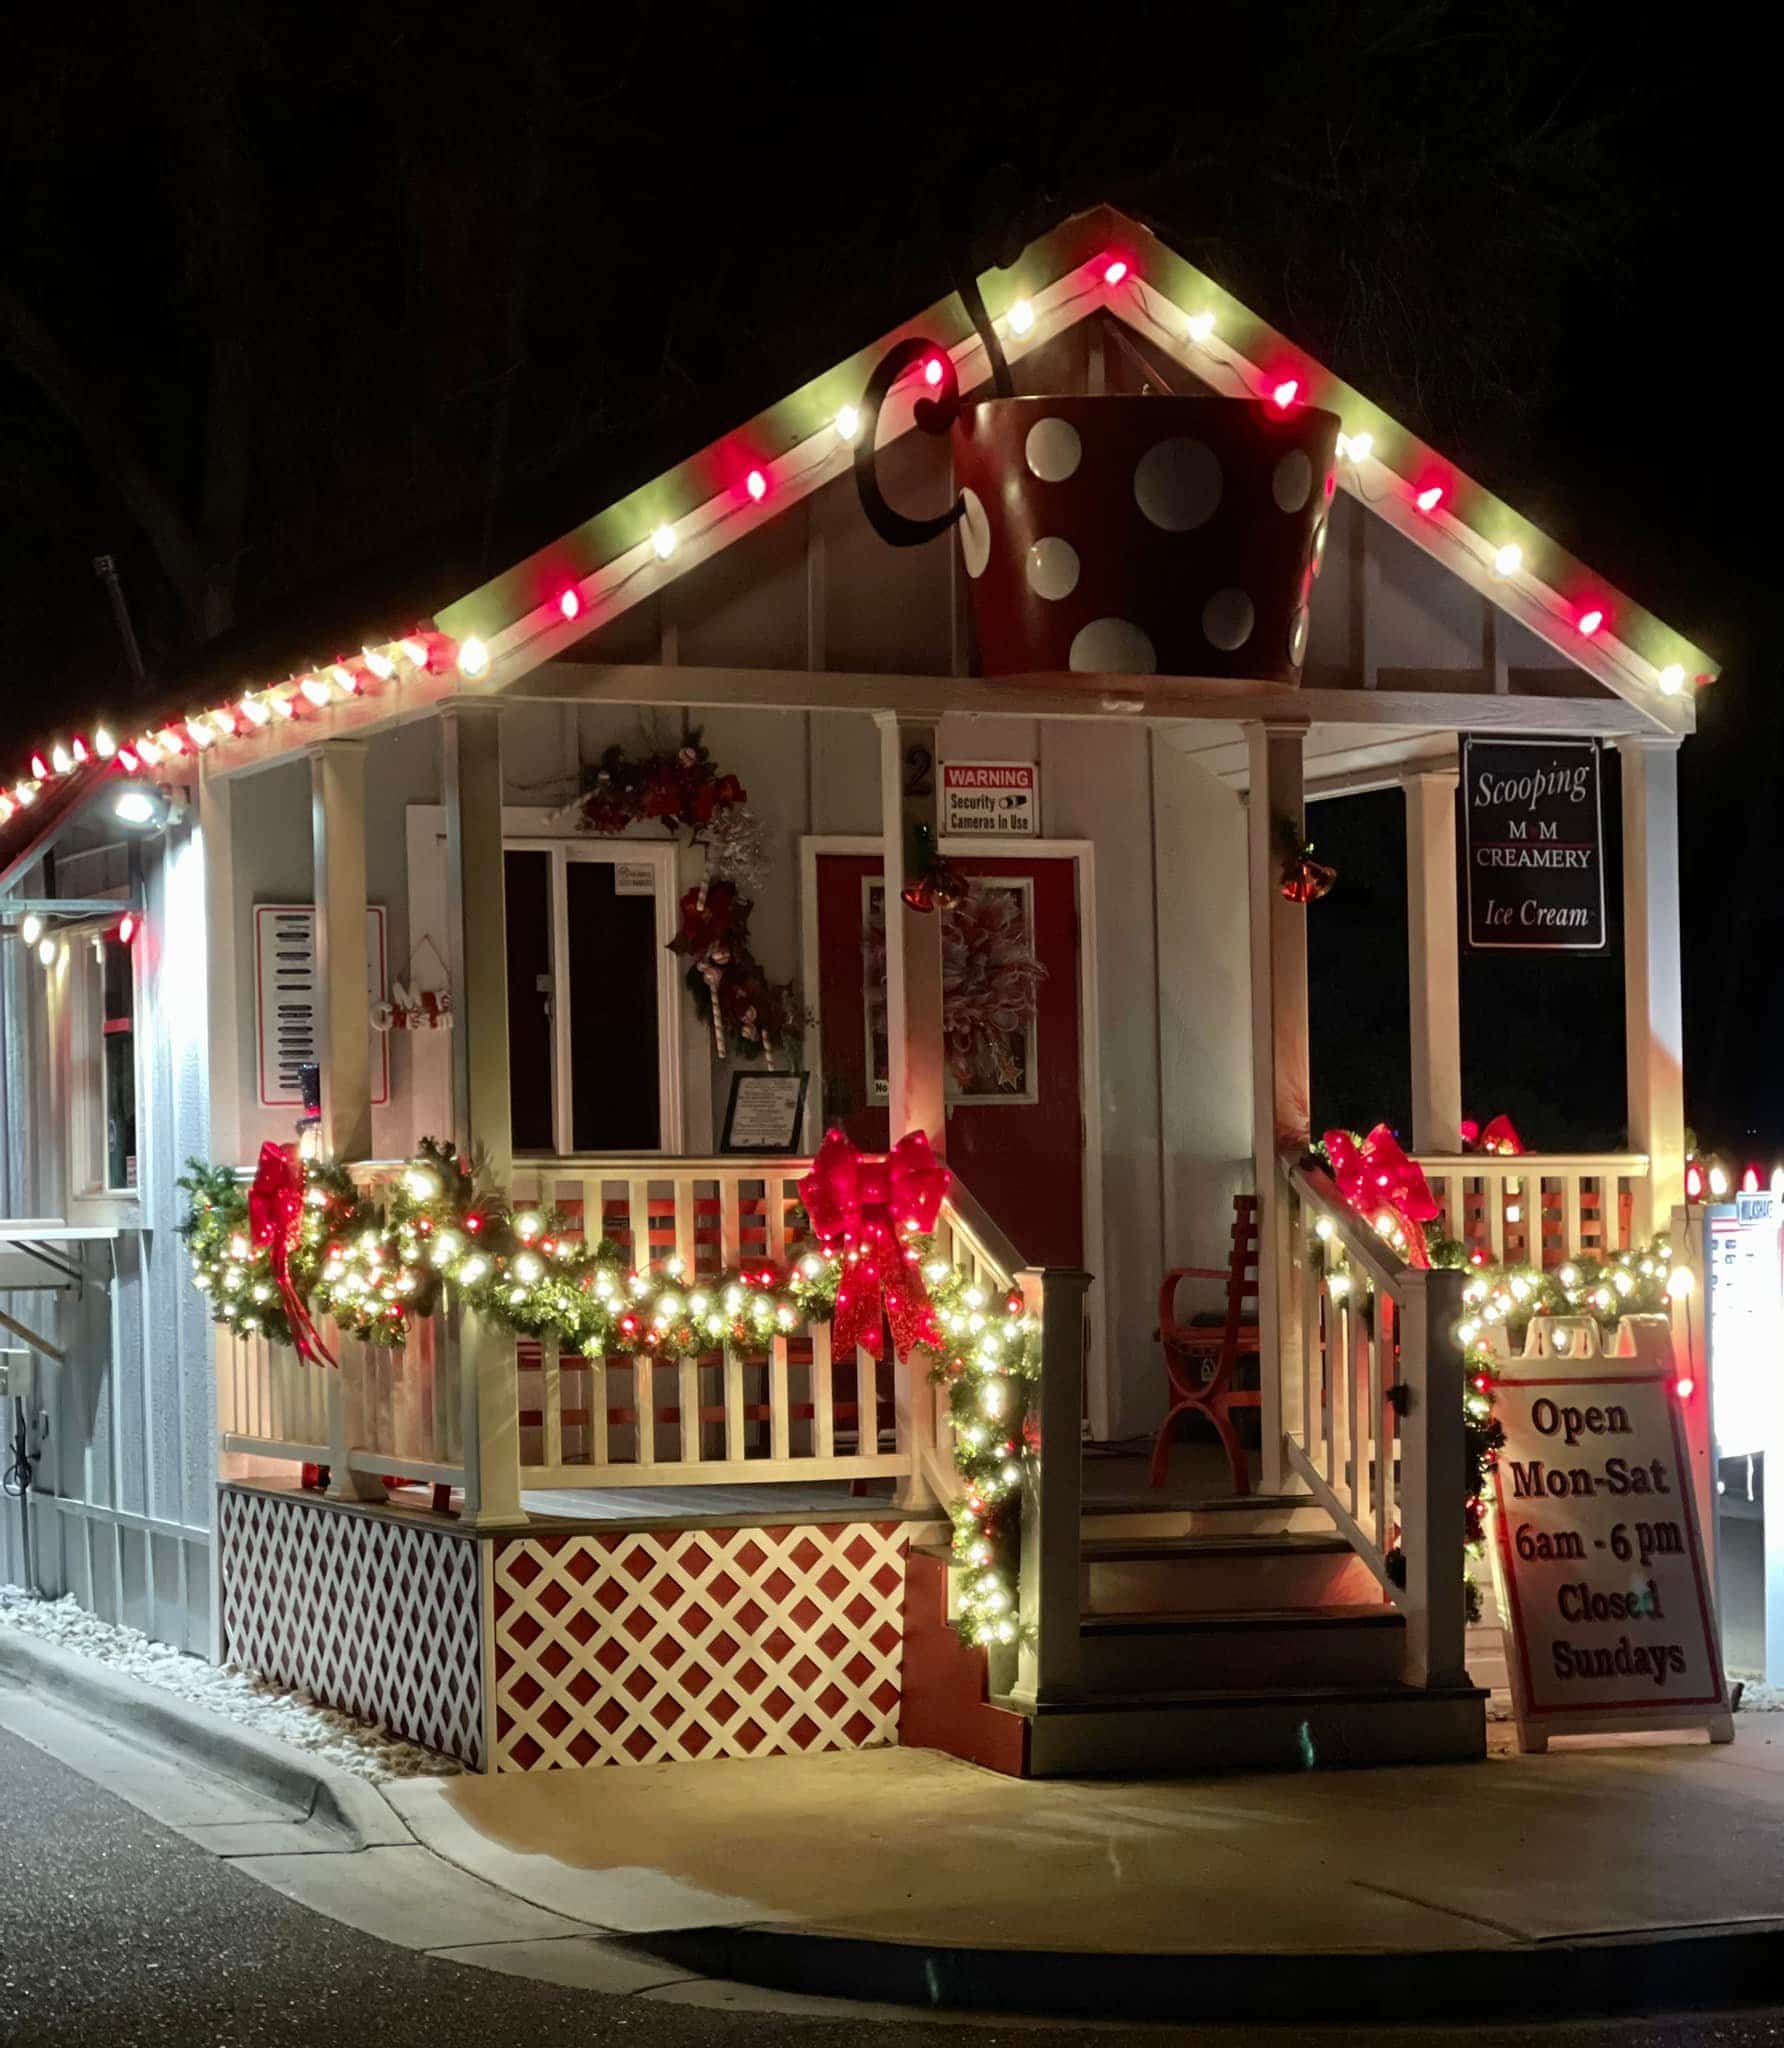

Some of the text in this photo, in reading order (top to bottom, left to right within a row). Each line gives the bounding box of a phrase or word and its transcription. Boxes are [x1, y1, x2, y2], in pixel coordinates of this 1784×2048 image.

[949, 769, 1029, 786] WARNING
[1474, 760, 1590, 812] Scooping
[951, 793, 996, 813] Security
[951, 813, 995, 829] Cameras
[1011, 814, 1029, 830] Use
[1476, 848, 1592, 869] CREAMERY
[1485, 899, 1589, 928] Ice Cream
[1531, 1398, 1632, 1445] Open
[1509, 1458, 1670, 1499] Mon-Sat
[1515, 1522, 1587, 1561] 6am
[1557, 1578, 1664, 1623] Closed
[1552, 1634, 1687, 1686] Sundays
